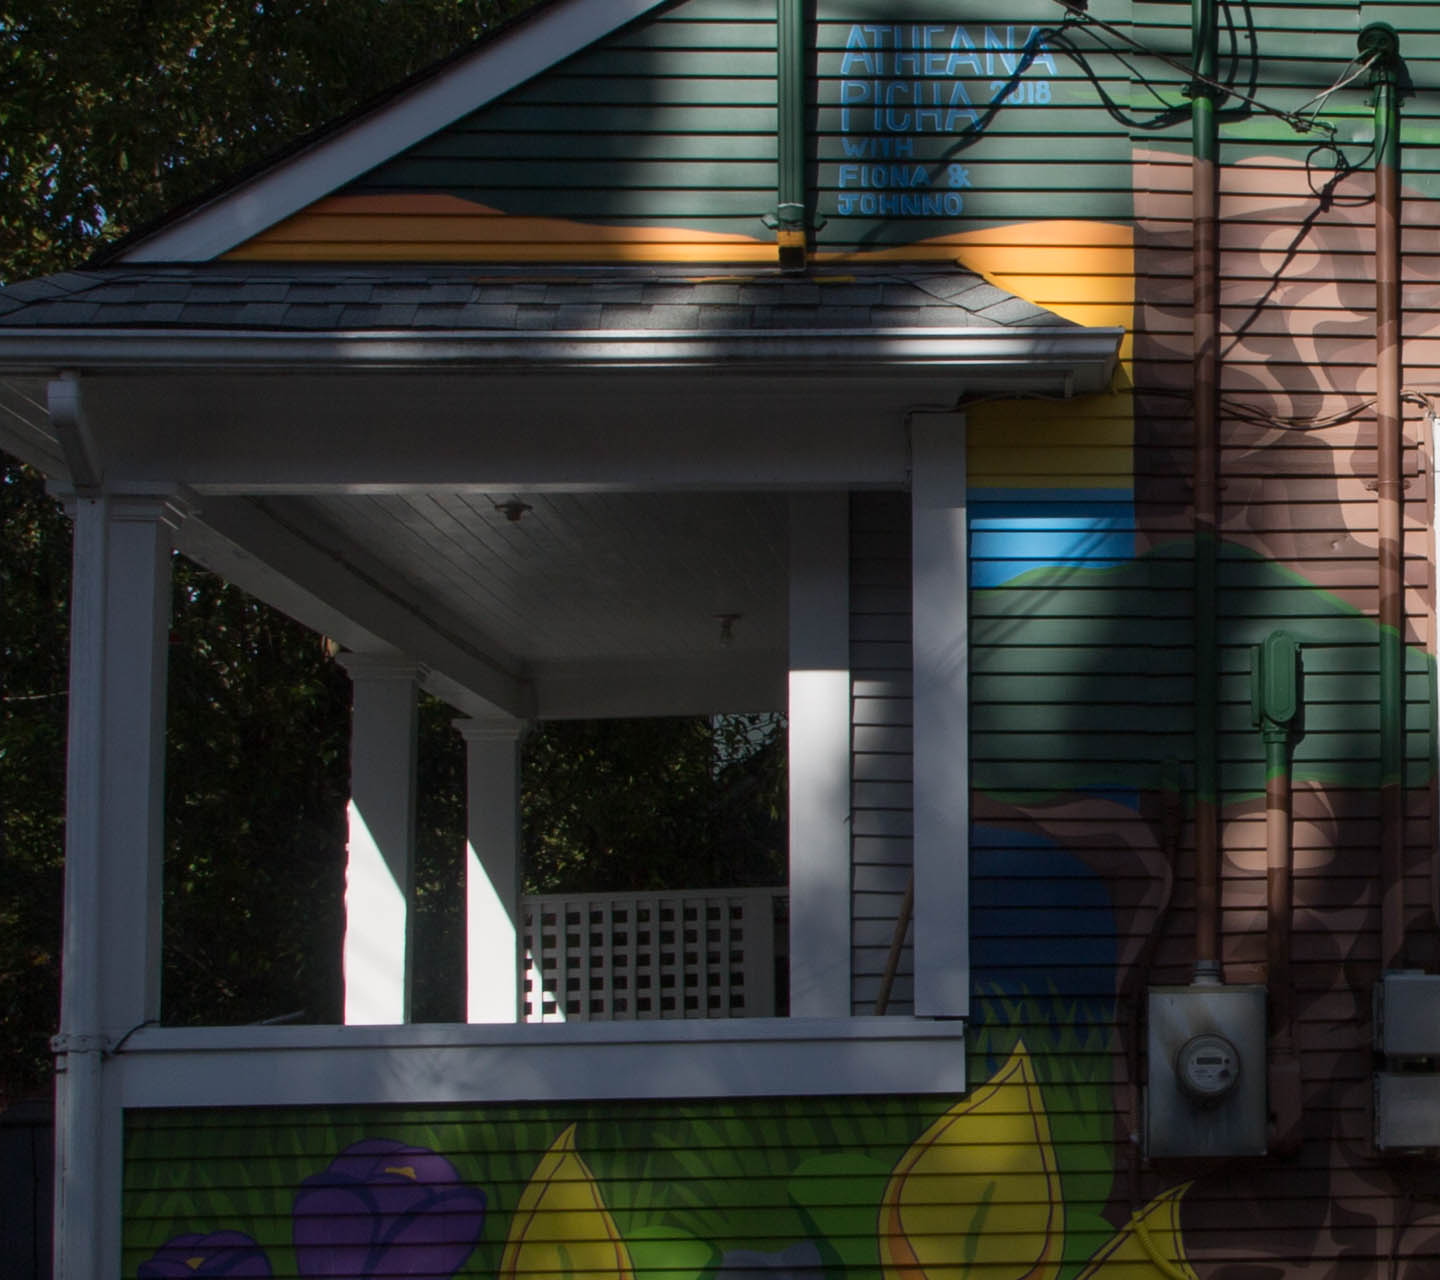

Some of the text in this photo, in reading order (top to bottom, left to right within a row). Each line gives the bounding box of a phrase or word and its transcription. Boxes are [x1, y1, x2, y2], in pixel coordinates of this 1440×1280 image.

[841, 24, 1057, 77] ATHEANA
[841, 79, 1052, 133] PICHA 2018
[841, 137, 914, 159] WITH
[839, 164, 973, 189] FIONA &
[837, 193, 964, 217] JOHNNO
